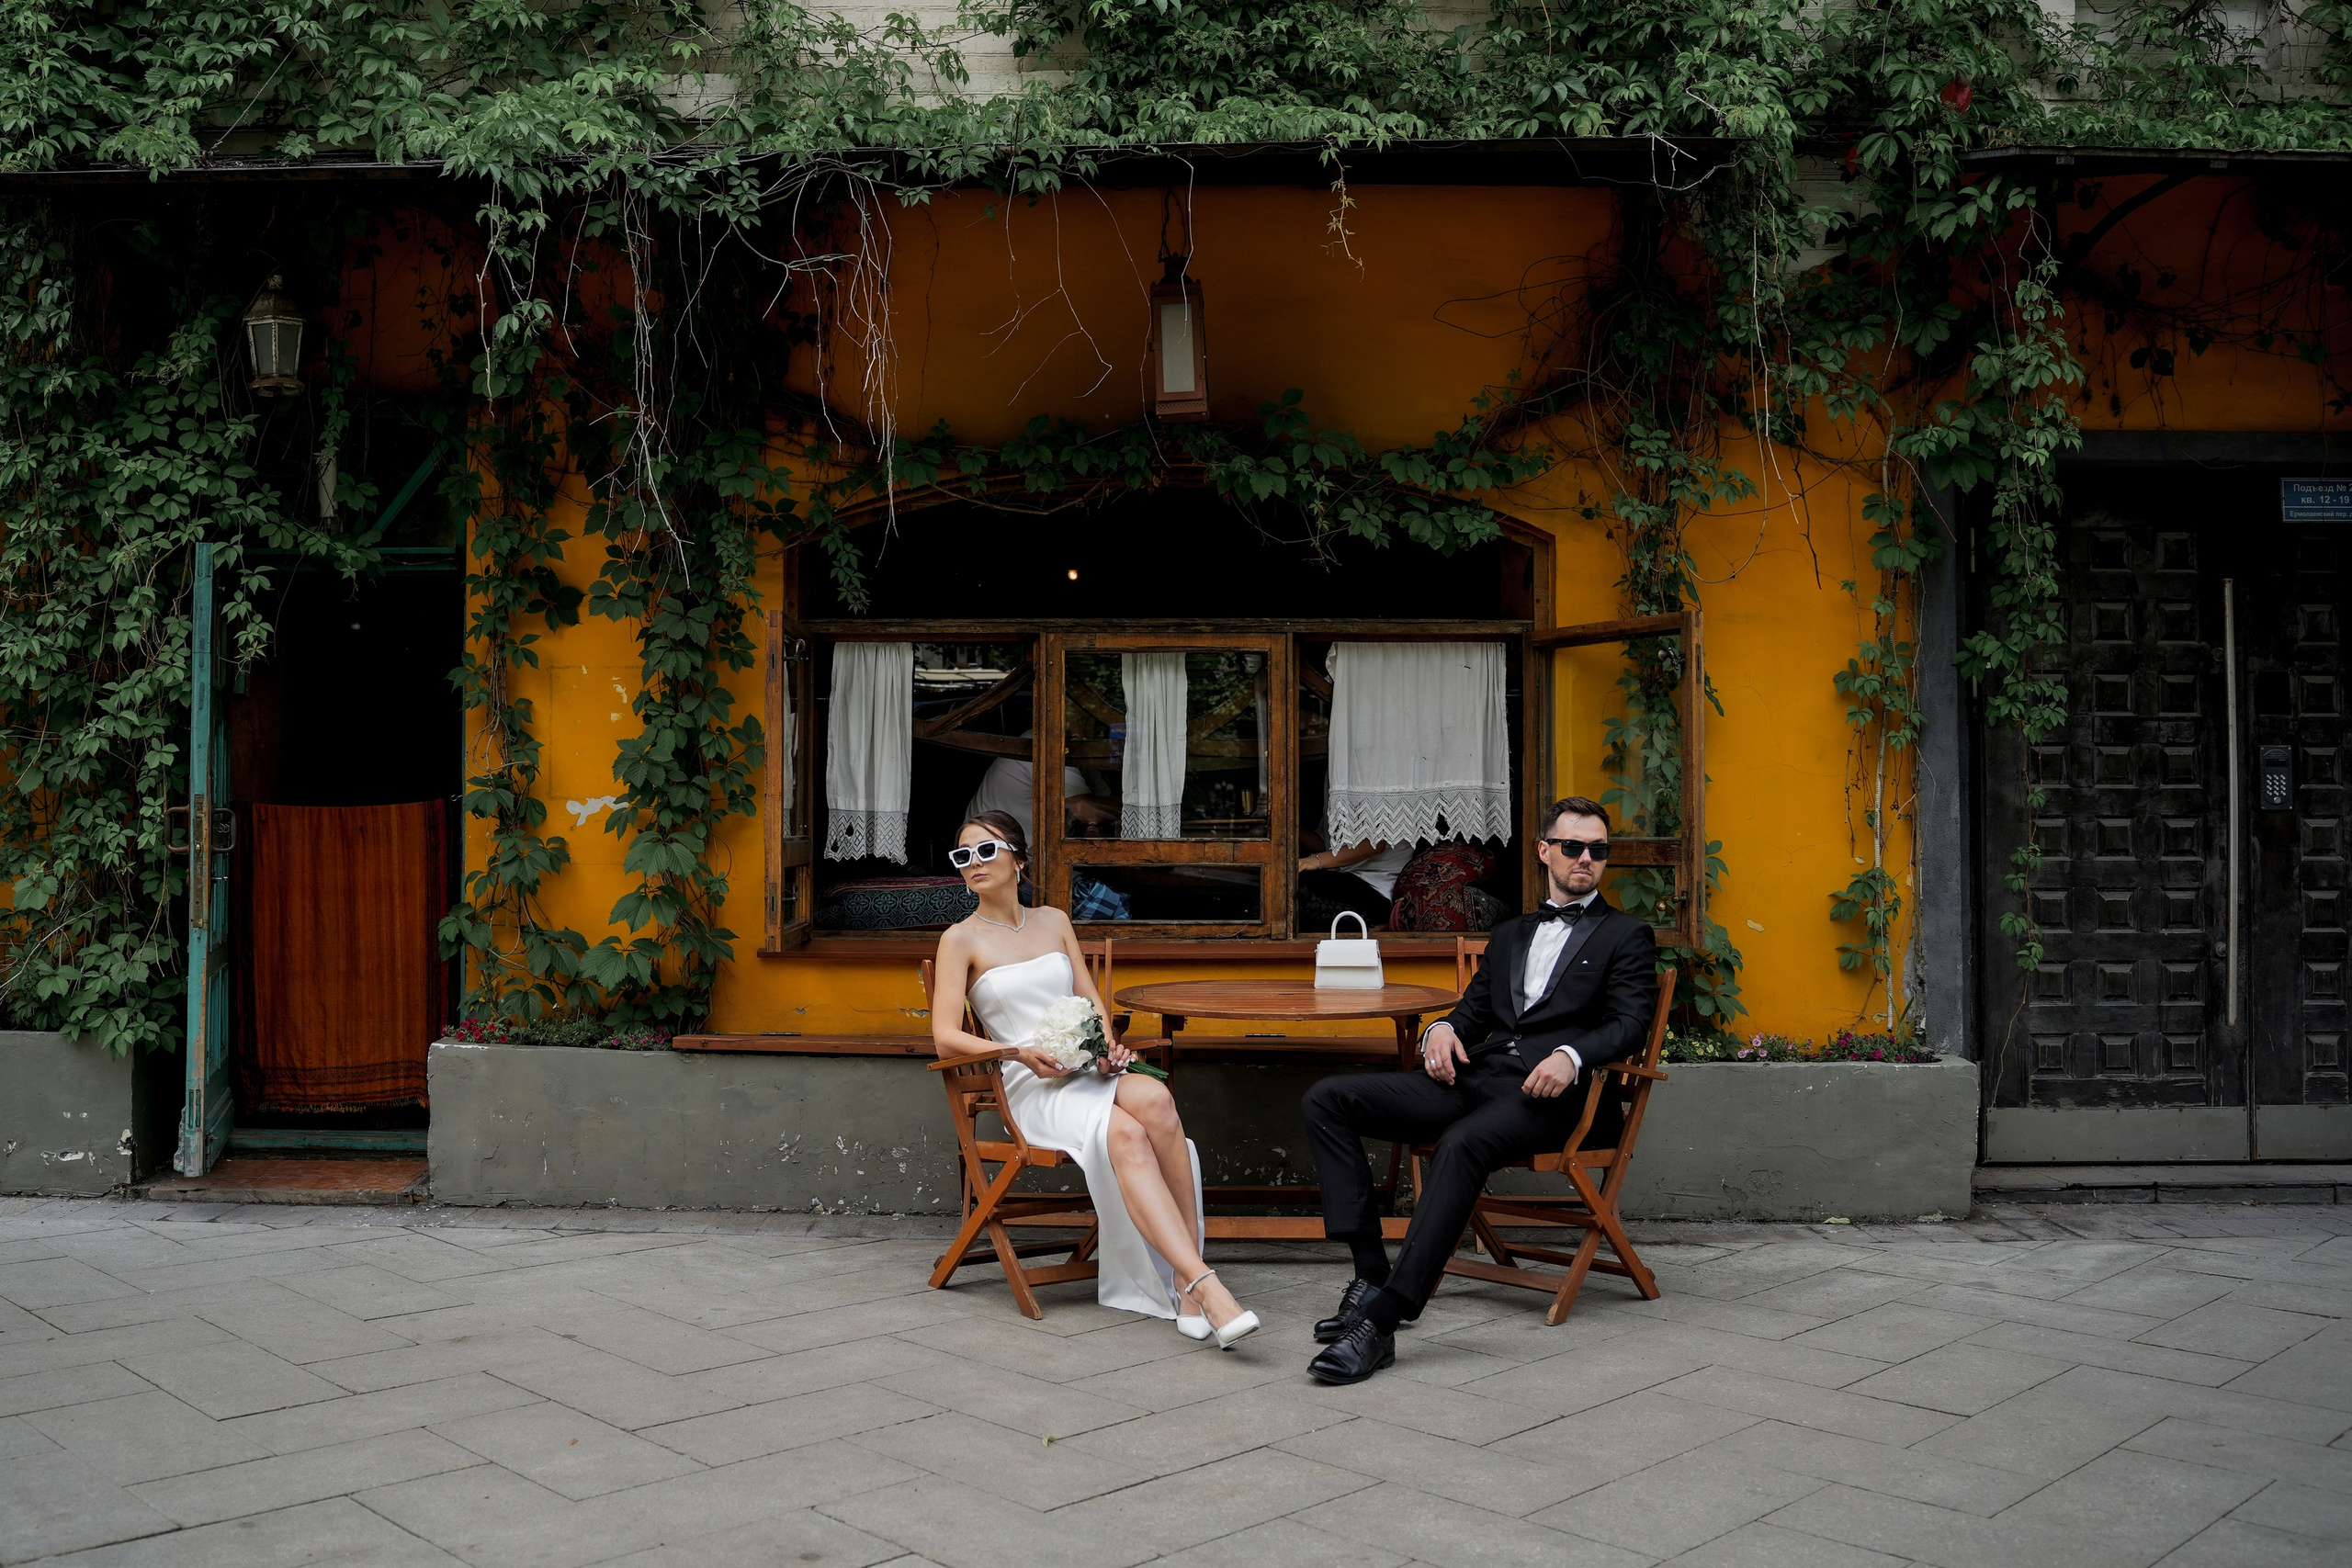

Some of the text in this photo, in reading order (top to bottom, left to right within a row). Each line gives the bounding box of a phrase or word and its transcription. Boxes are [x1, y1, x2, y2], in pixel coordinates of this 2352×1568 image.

[2293, 483, 2335, 492] Подъезд
[2336, 483, 2346, 491] №
[2319, 495, 2330, 503] 12
[2339, 495, 2350, 503] 19
[2290, 510, 2335, 518] Ермолаевский
